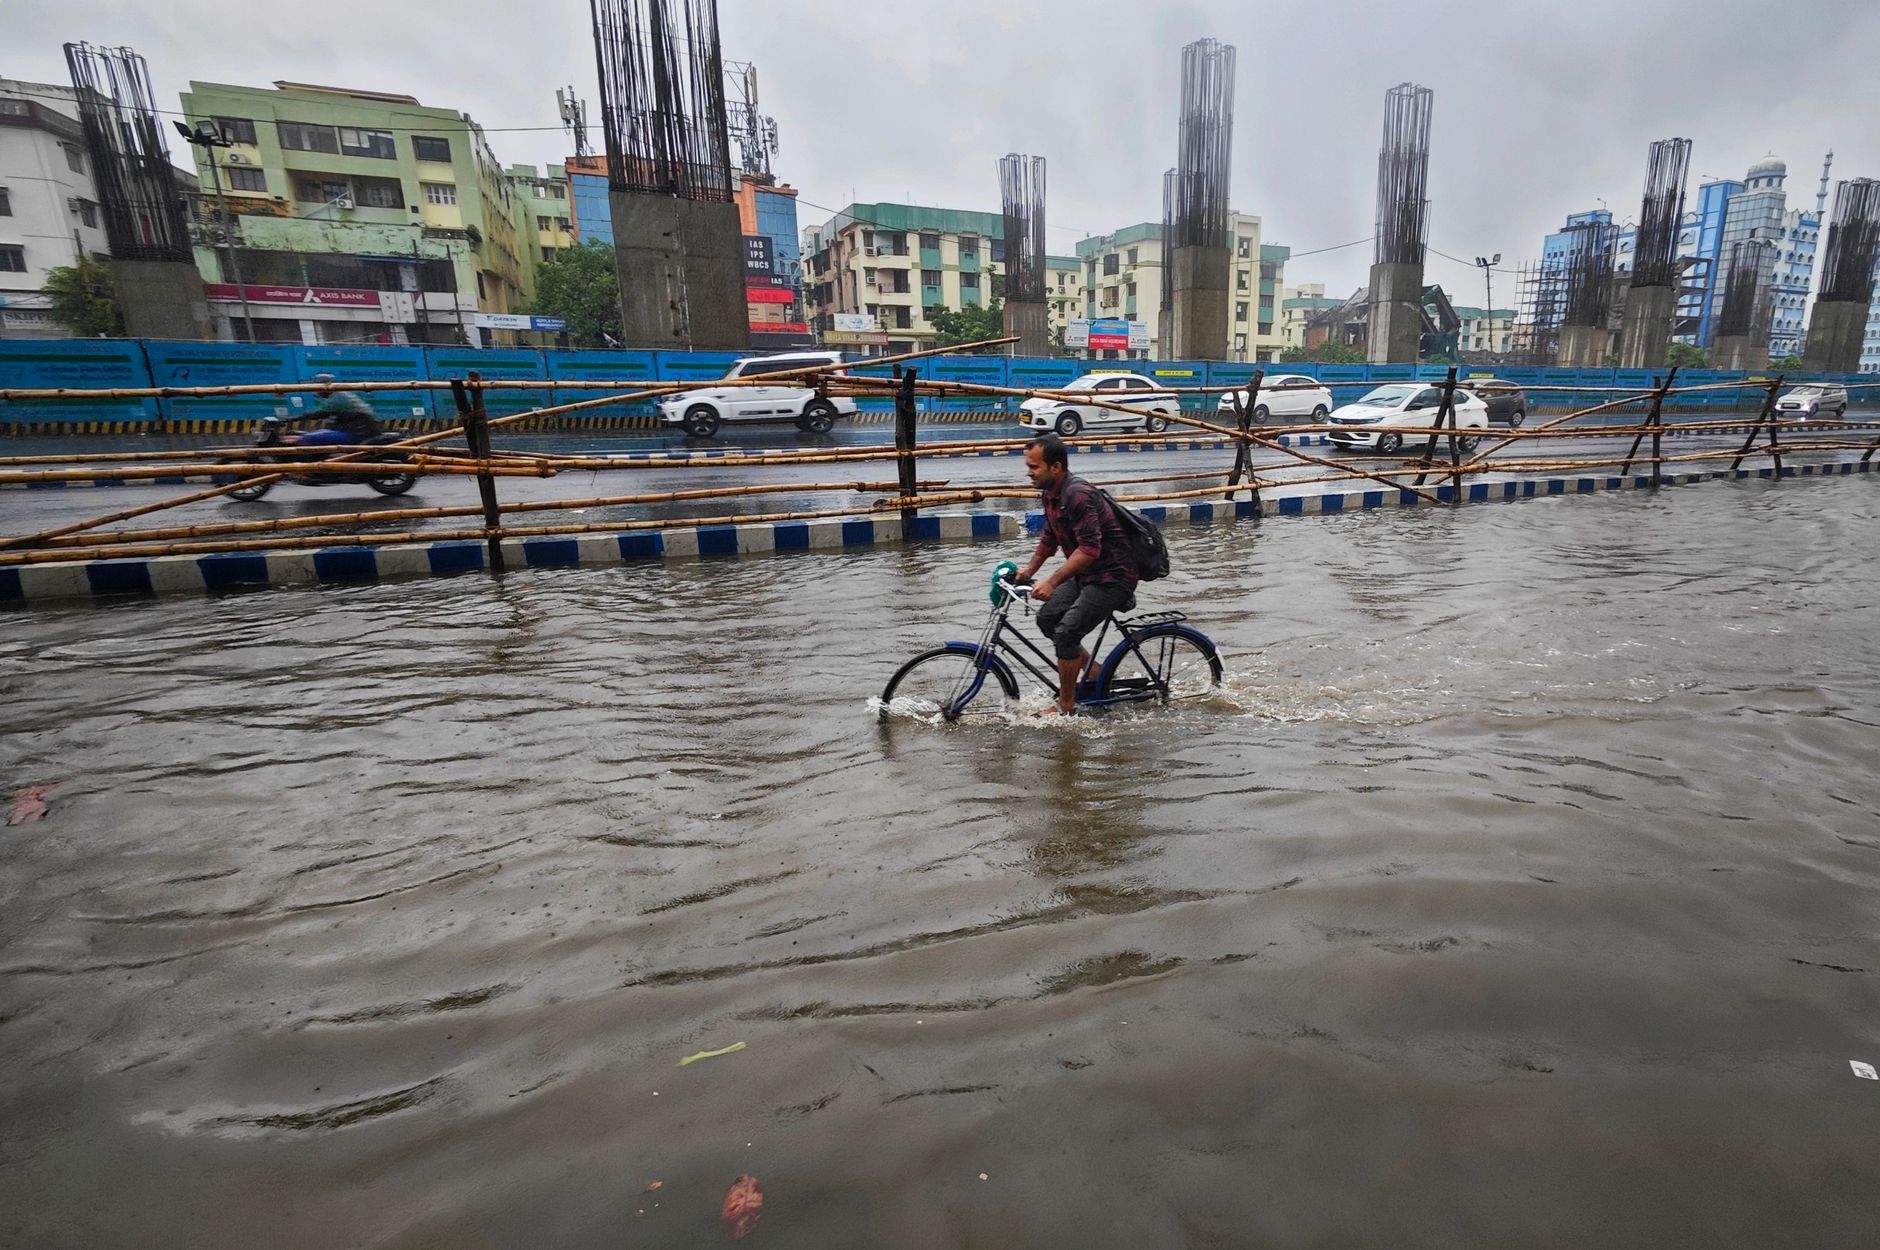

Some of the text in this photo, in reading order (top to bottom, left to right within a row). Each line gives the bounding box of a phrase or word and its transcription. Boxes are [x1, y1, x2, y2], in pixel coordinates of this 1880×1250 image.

[749, 240, 763, 249] IAS
[750, 251, 764, 259] IPS
[747, 261, 769, 269] WBCS
[771, 277, 783, 285] IAS
